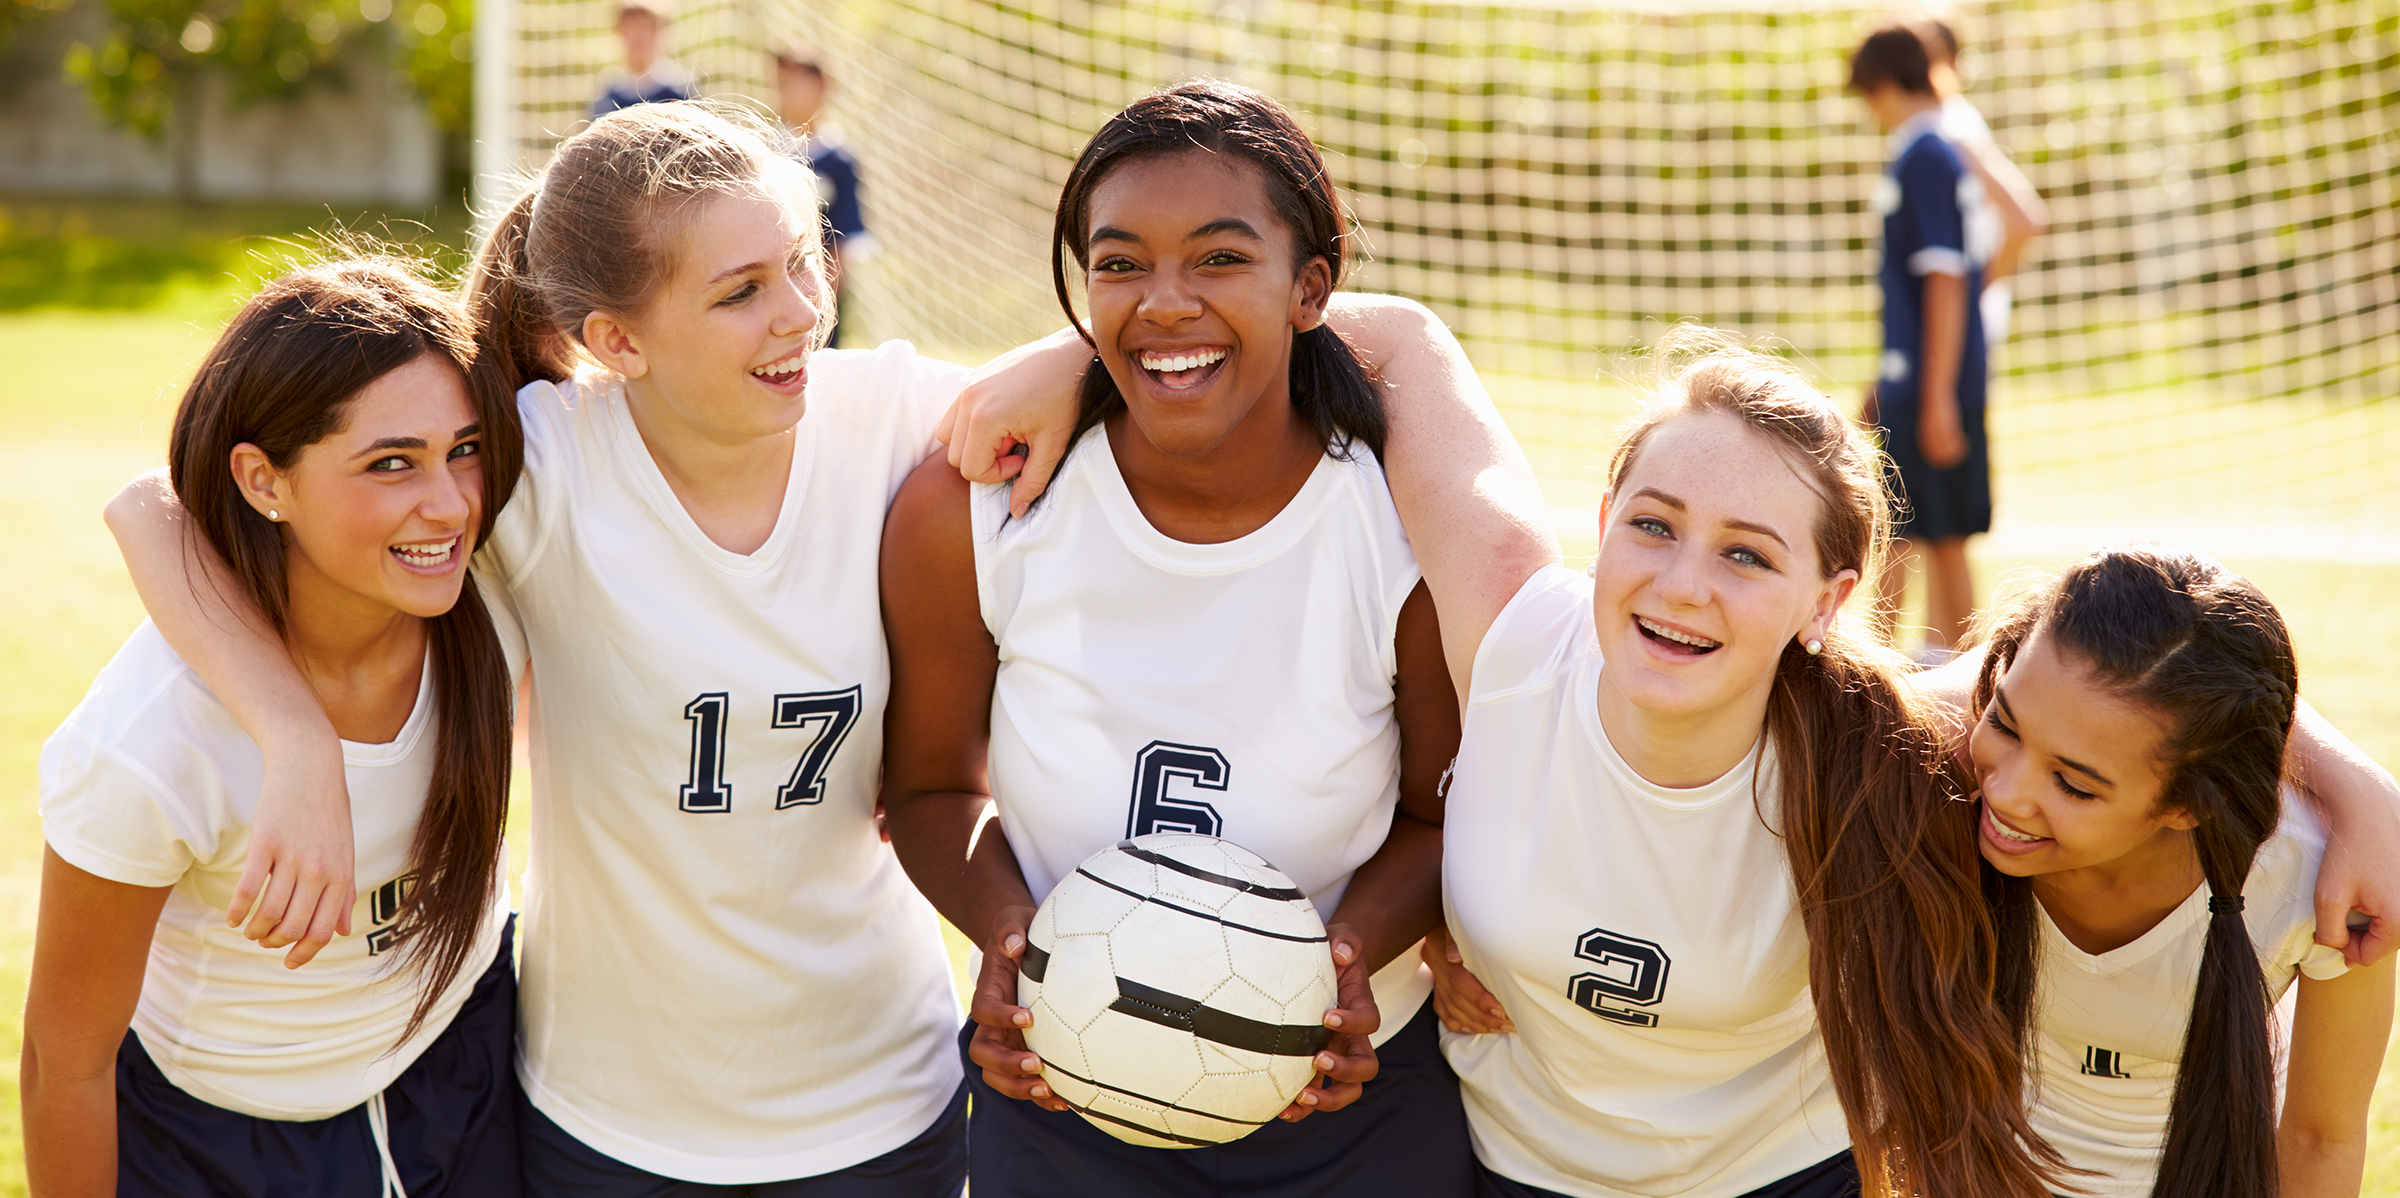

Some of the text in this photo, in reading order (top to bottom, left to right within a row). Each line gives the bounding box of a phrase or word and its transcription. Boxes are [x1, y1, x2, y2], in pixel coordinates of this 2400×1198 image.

[679, 683, 862, 813] 17
[1125, 740, 1231, 840] 6
[1567, 927, 1672, 1028] 2
